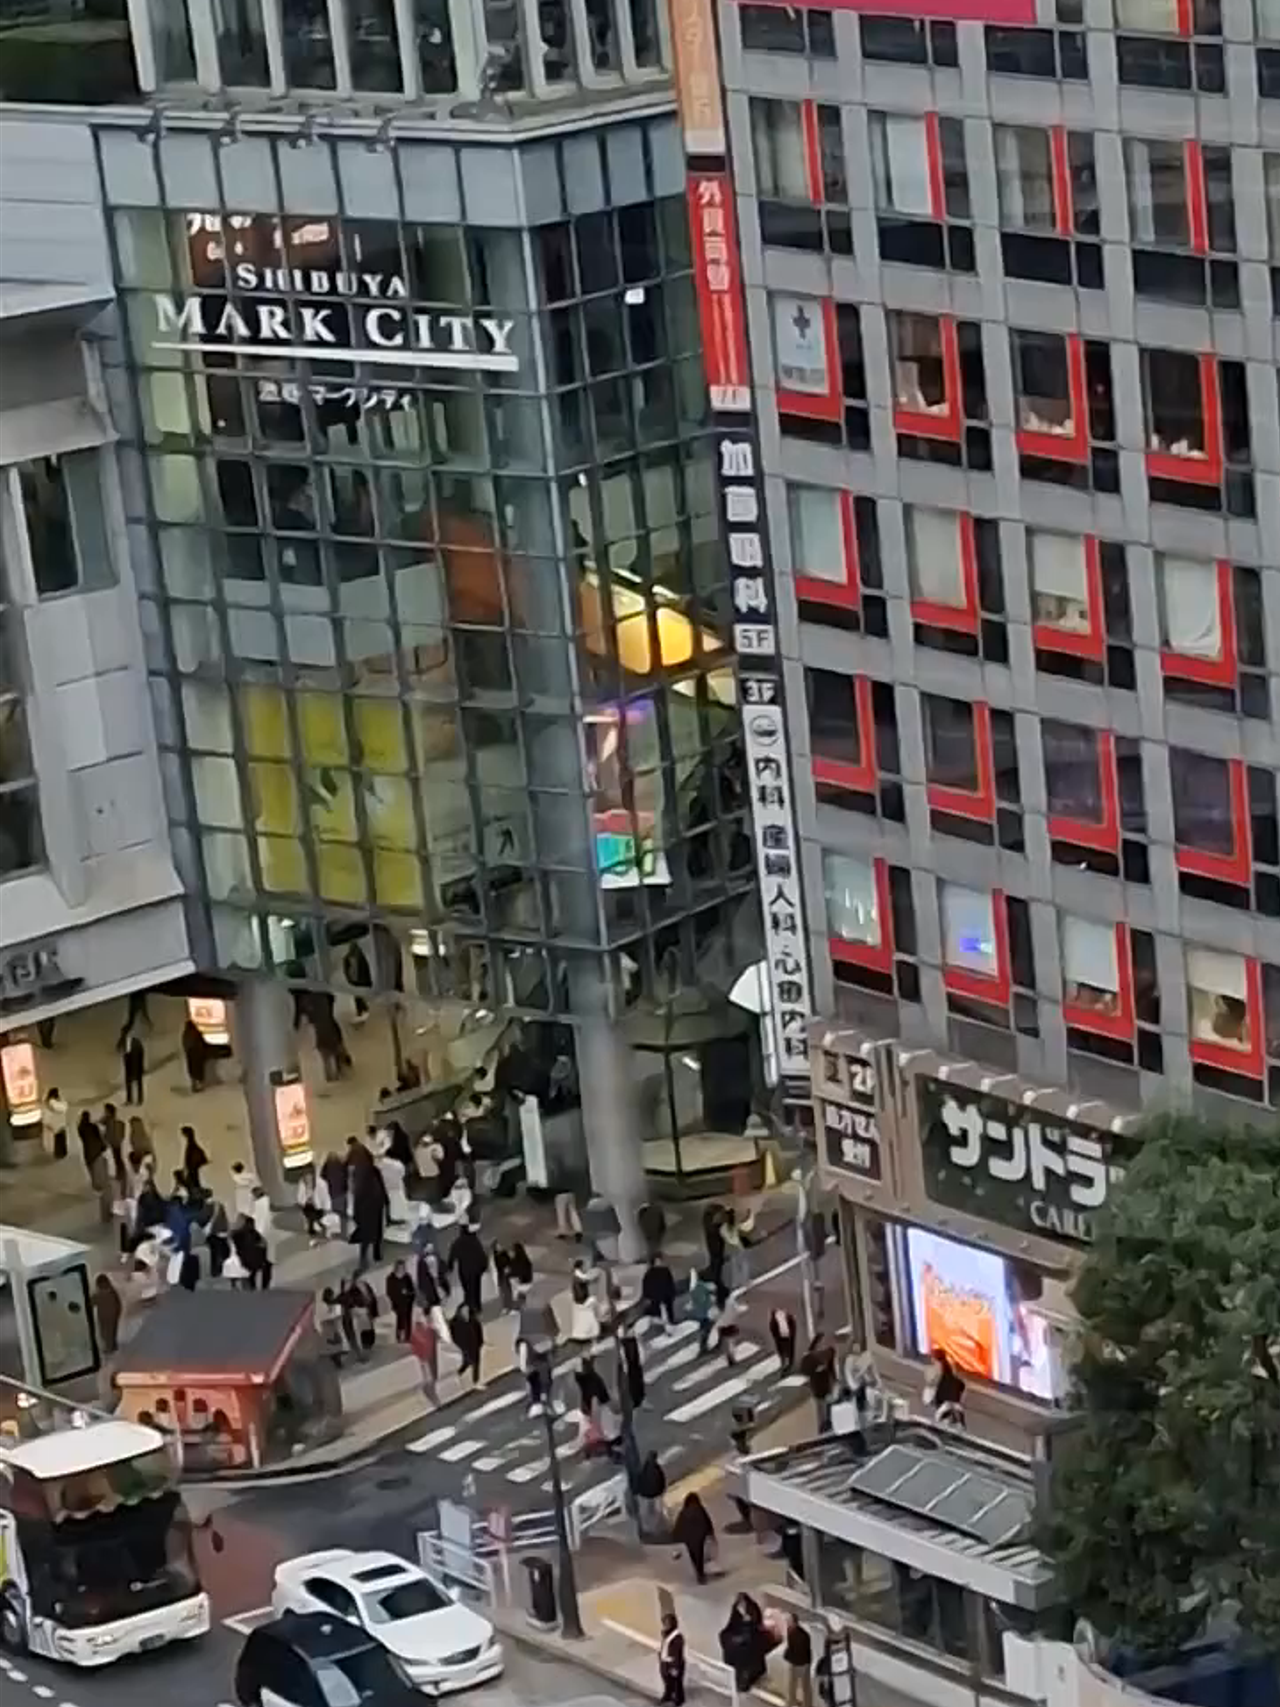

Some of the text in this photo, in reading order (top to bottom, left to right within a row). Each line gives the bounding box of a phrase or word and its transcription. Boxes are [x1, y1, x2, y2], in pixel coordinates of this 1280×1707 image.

[236, 262, 408, 300] SHIBUYA
[154, 294, 516, 355] MARK CITY
